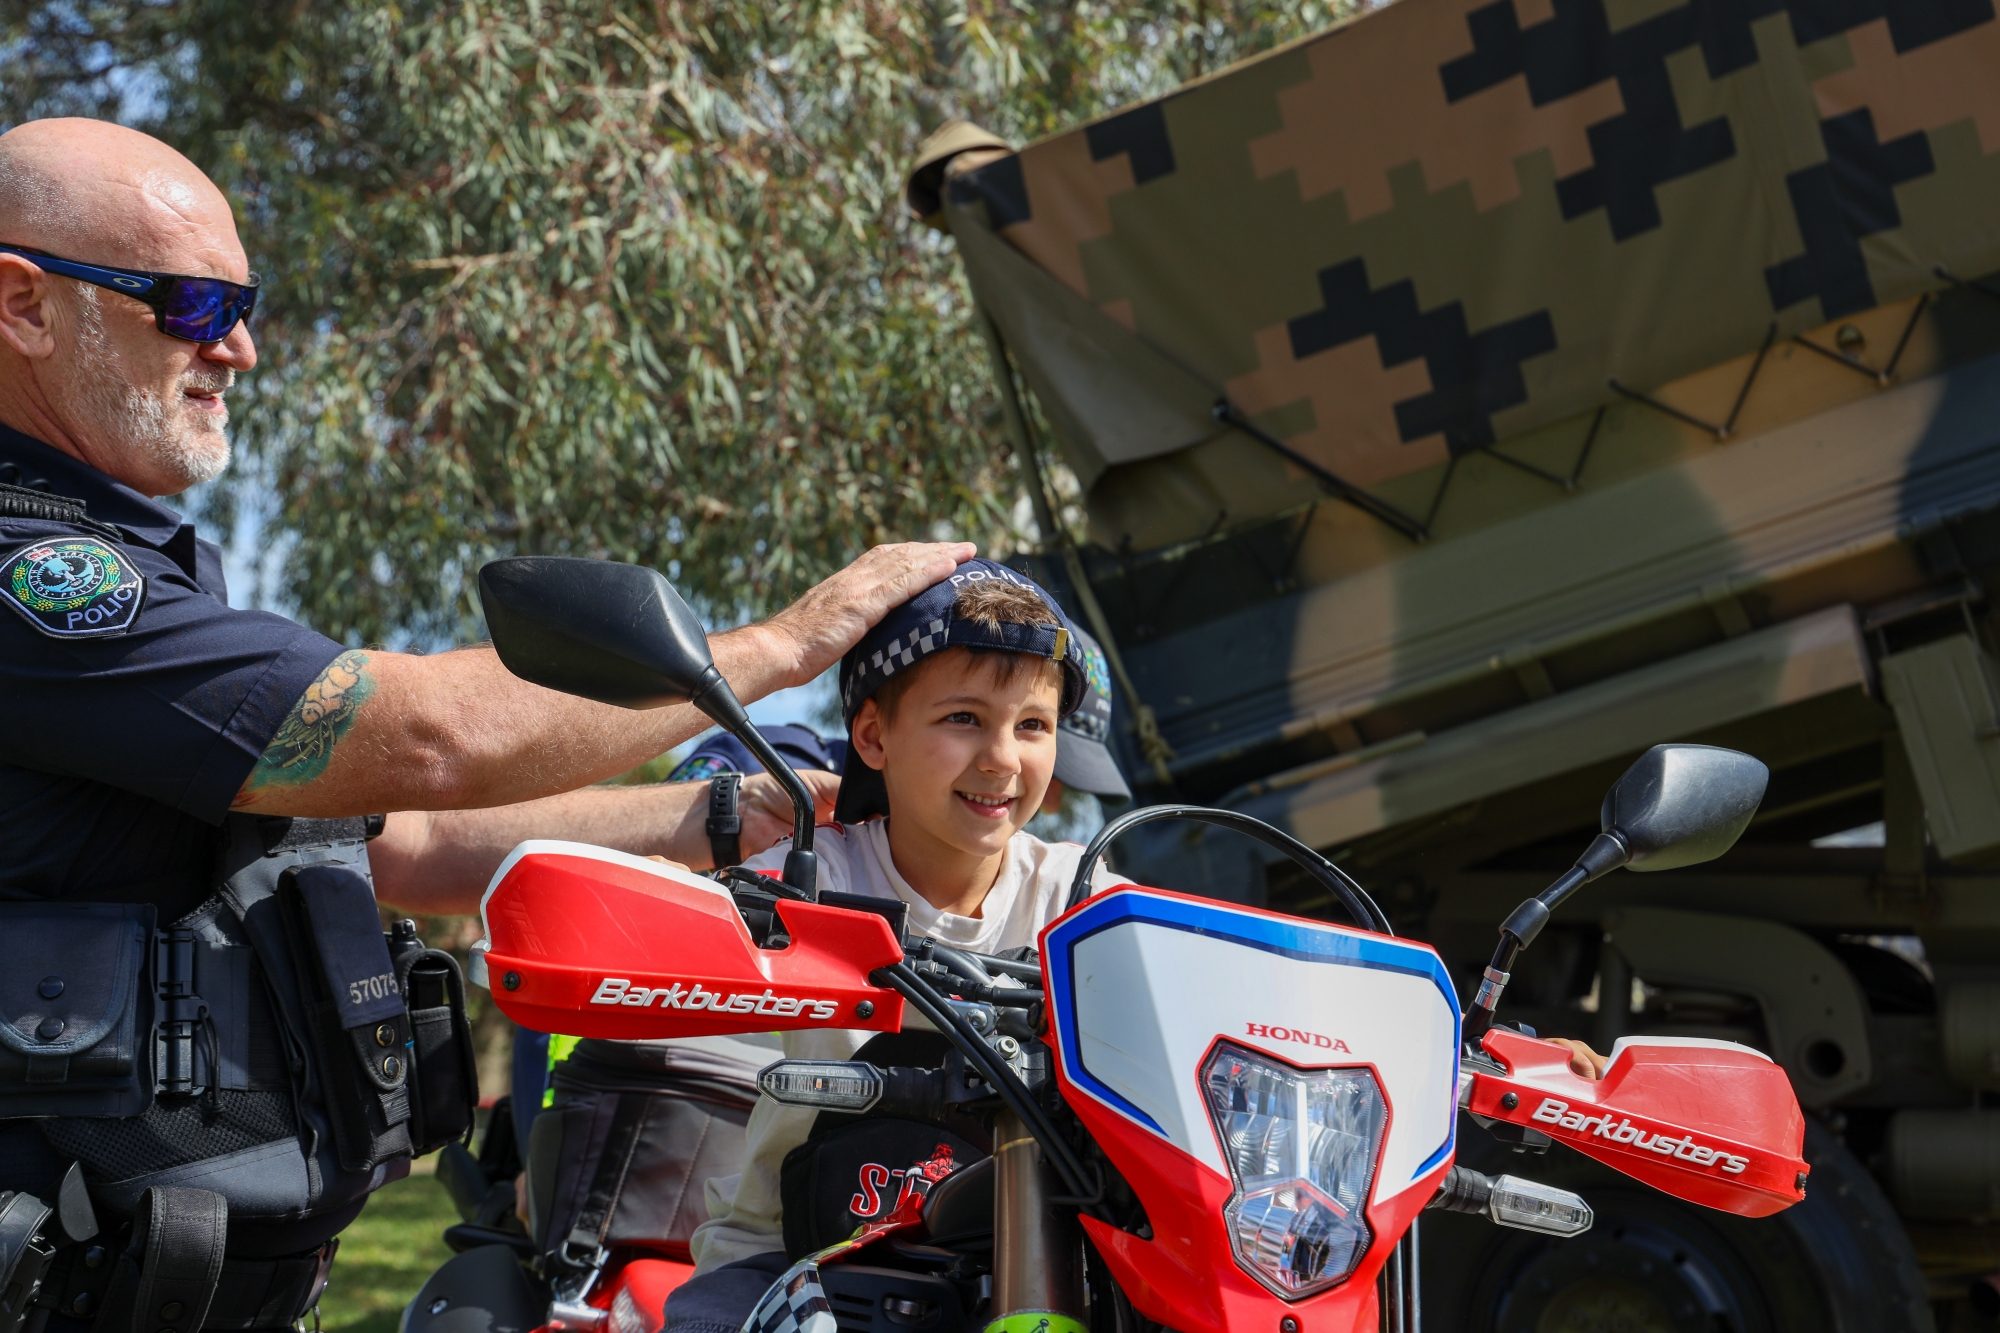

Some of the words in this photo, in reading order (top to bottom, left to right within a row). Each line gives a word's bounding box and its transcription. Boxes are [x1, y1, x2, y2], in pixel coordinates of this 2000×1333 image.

[590, 978, 839, 1020] Barkbusters
[1246, 1022, 1353, 1054] HONDA
[1531, 1097, 1750, 1174] Barkbusters
